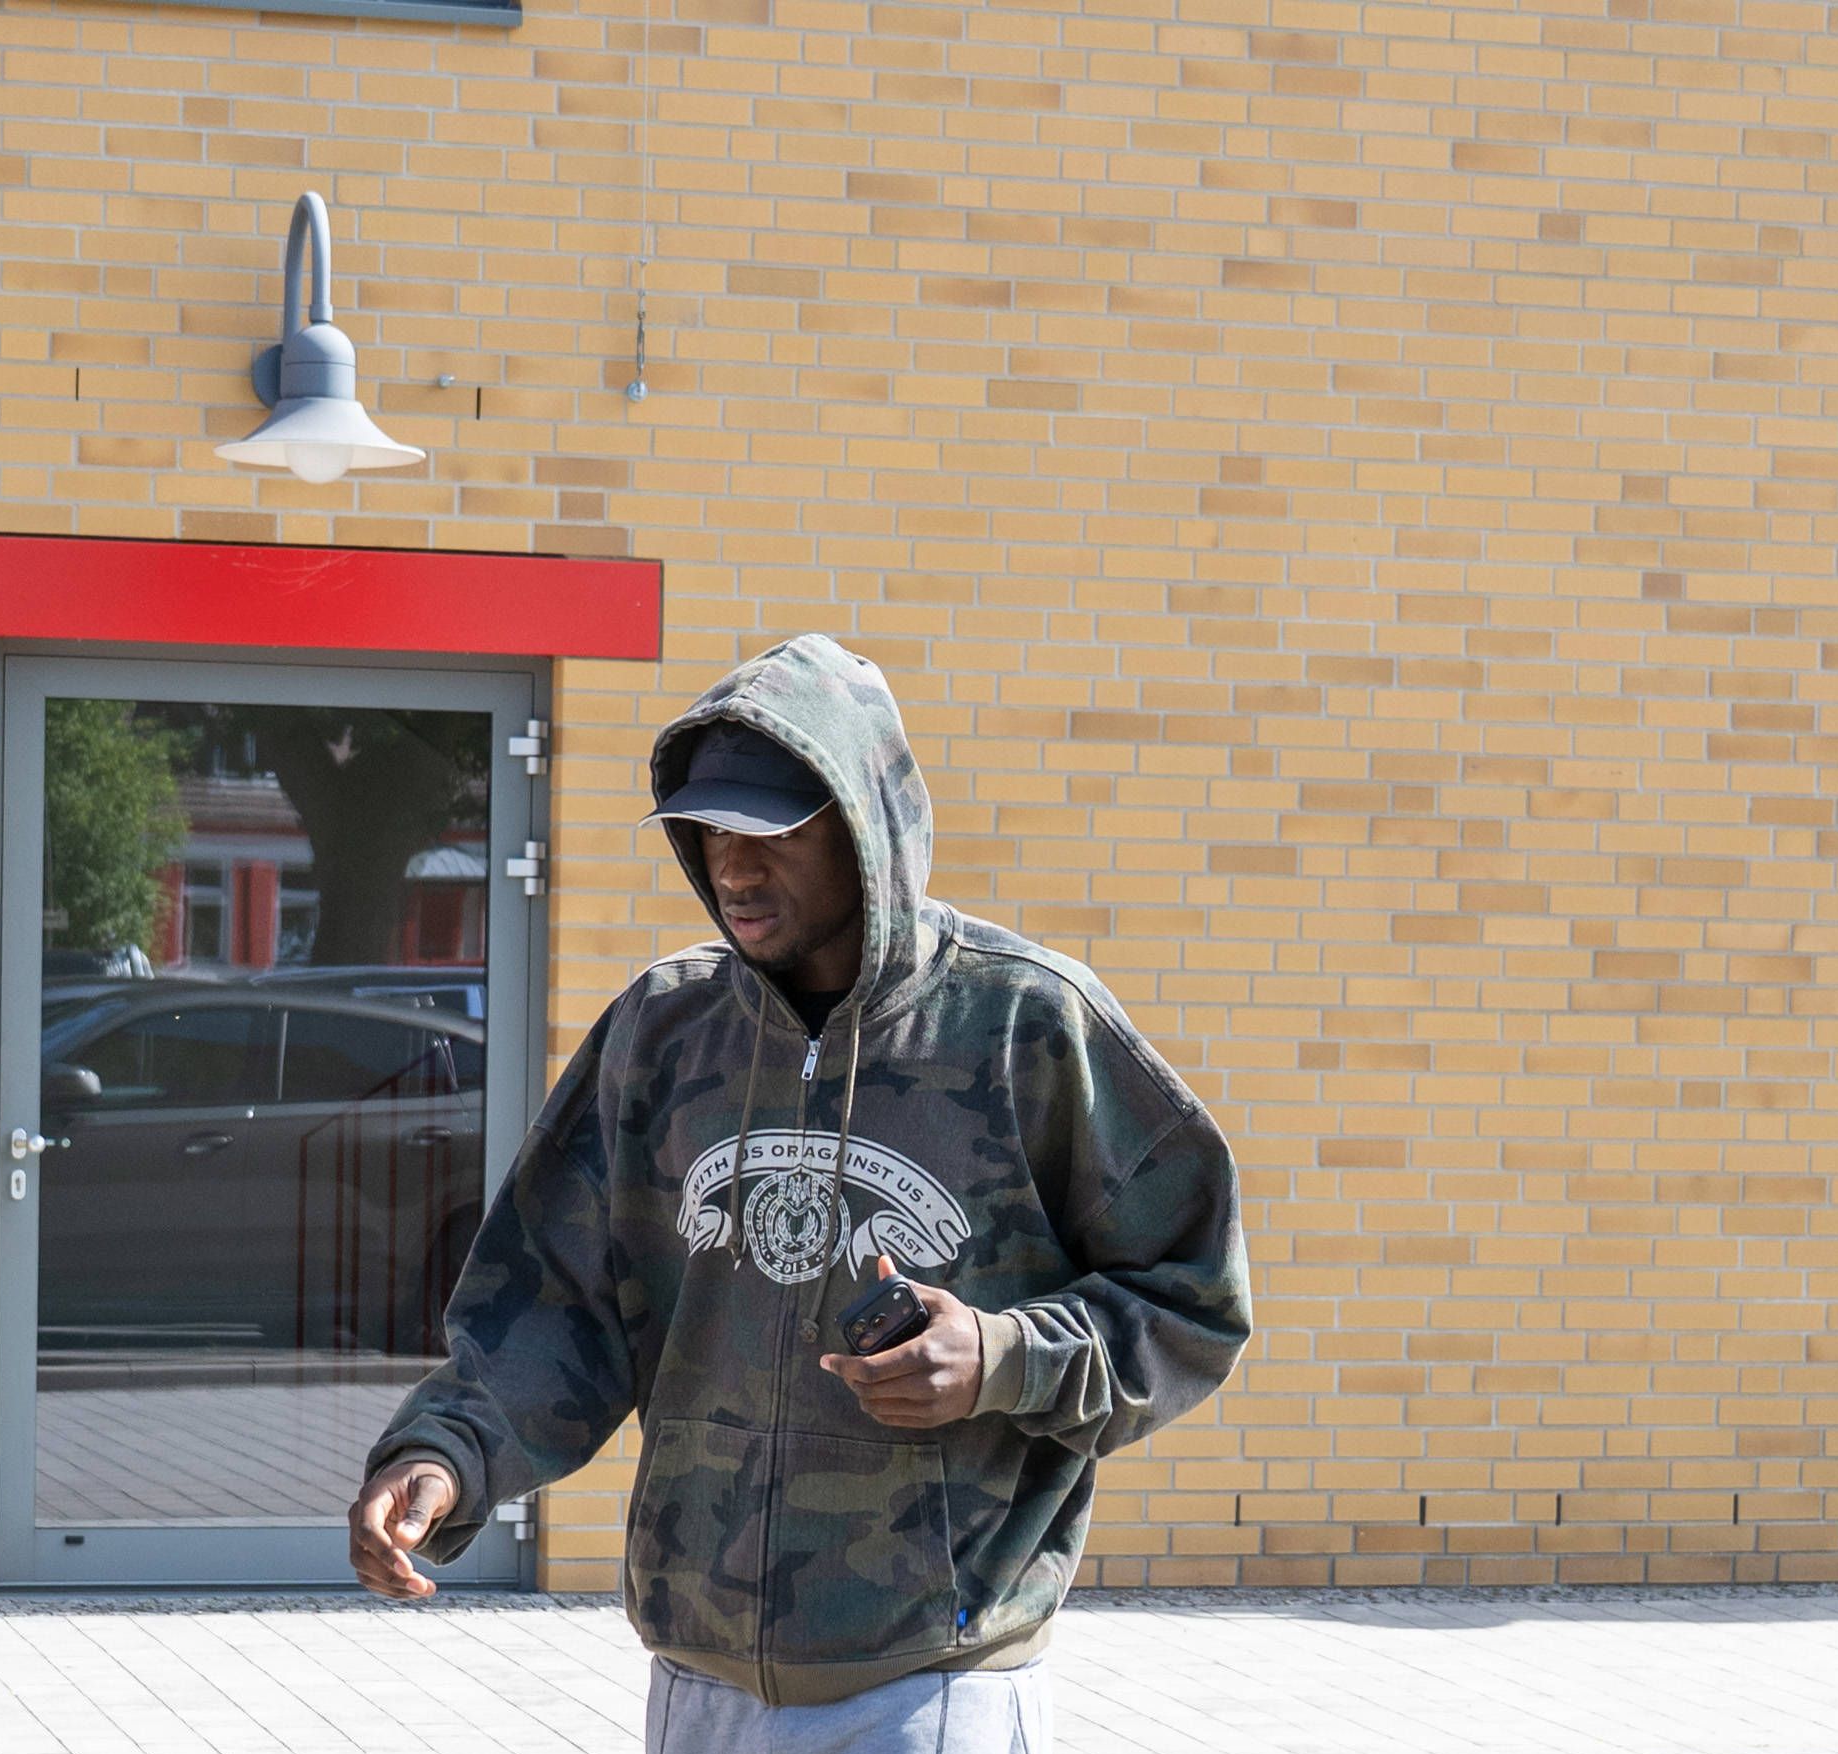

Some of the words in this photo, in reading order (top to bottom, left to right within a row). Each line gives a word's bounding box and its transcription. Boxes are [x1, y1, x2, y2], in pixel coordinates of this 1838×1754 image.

[693, 1157, 729, 1197] WITH
[771, 1145, 799, 1158] OR
[897, 1177, 924, 1202] US
[756, 1192, 778, 1231] GLOBAL
[886, 1224, 924, 1256] FAST
[772, 1259, 811, 1274] 2013
